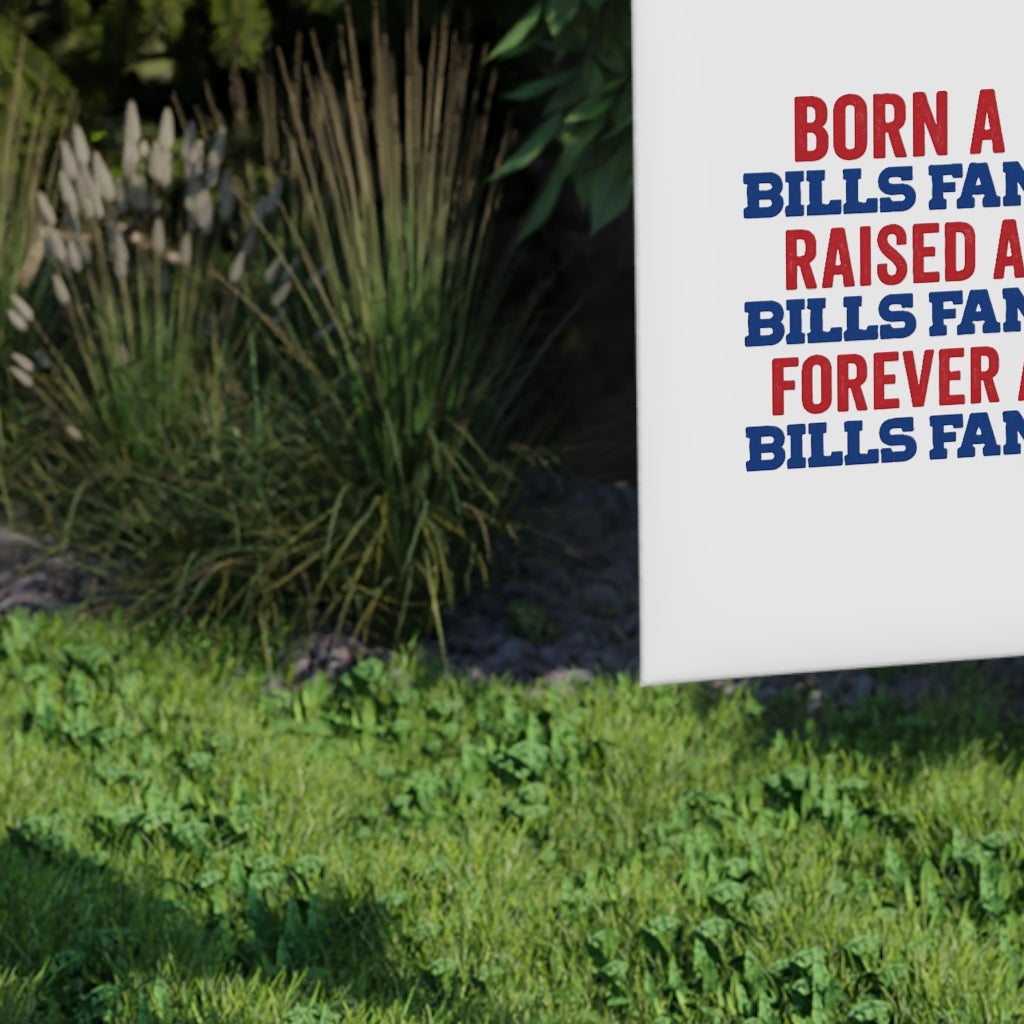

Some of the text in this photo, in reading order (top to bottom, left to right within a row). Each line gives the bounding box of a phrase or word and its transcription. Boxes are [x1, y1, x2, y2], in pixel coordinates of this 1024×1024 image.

[793, 88, 1006, 163] BORN A
[743, 166, 917, 219] BILLS
[785, 221, 976, 291] RAISED
[744, 293, 917, 347] BILLS
[771, 345, 1000, 417] FOREVER
[745, 417, 917, 472] BILLS
